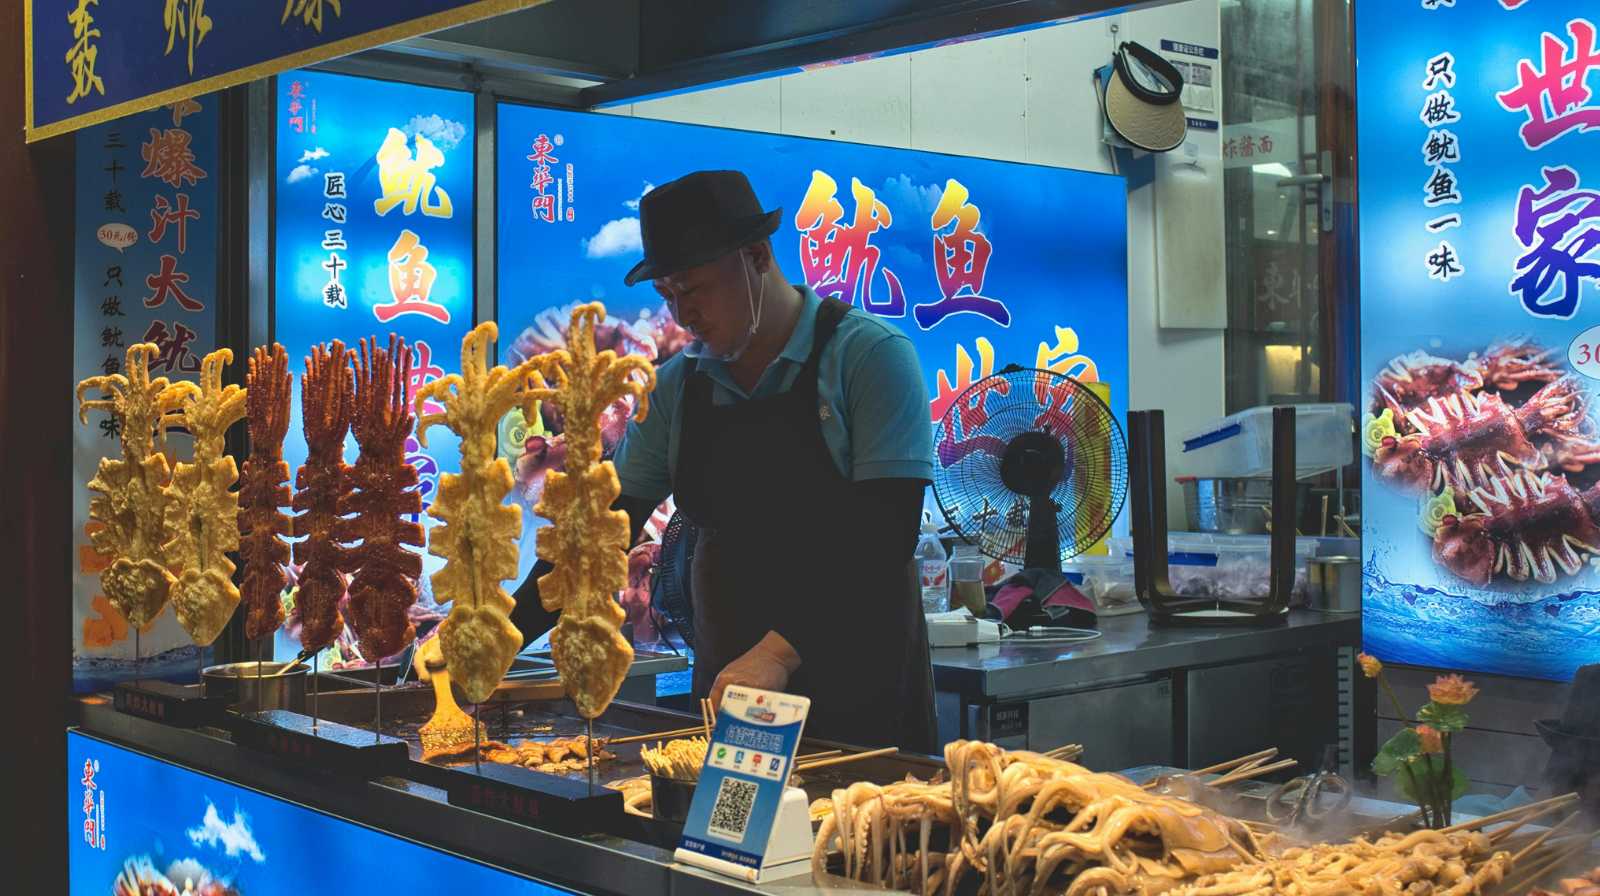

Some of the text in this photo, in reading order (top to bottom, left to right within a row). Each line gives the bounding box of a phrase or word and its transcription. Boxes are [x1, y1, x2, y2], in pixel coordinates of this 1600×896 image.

[527, 134, 559, 222] 東華門
[1423, 54, 1461, 278] 只做鱿鱼一味
[322, 172, 347, 309] 匠心三十载
[795, 170, 1010, 329] 鱿鱼
